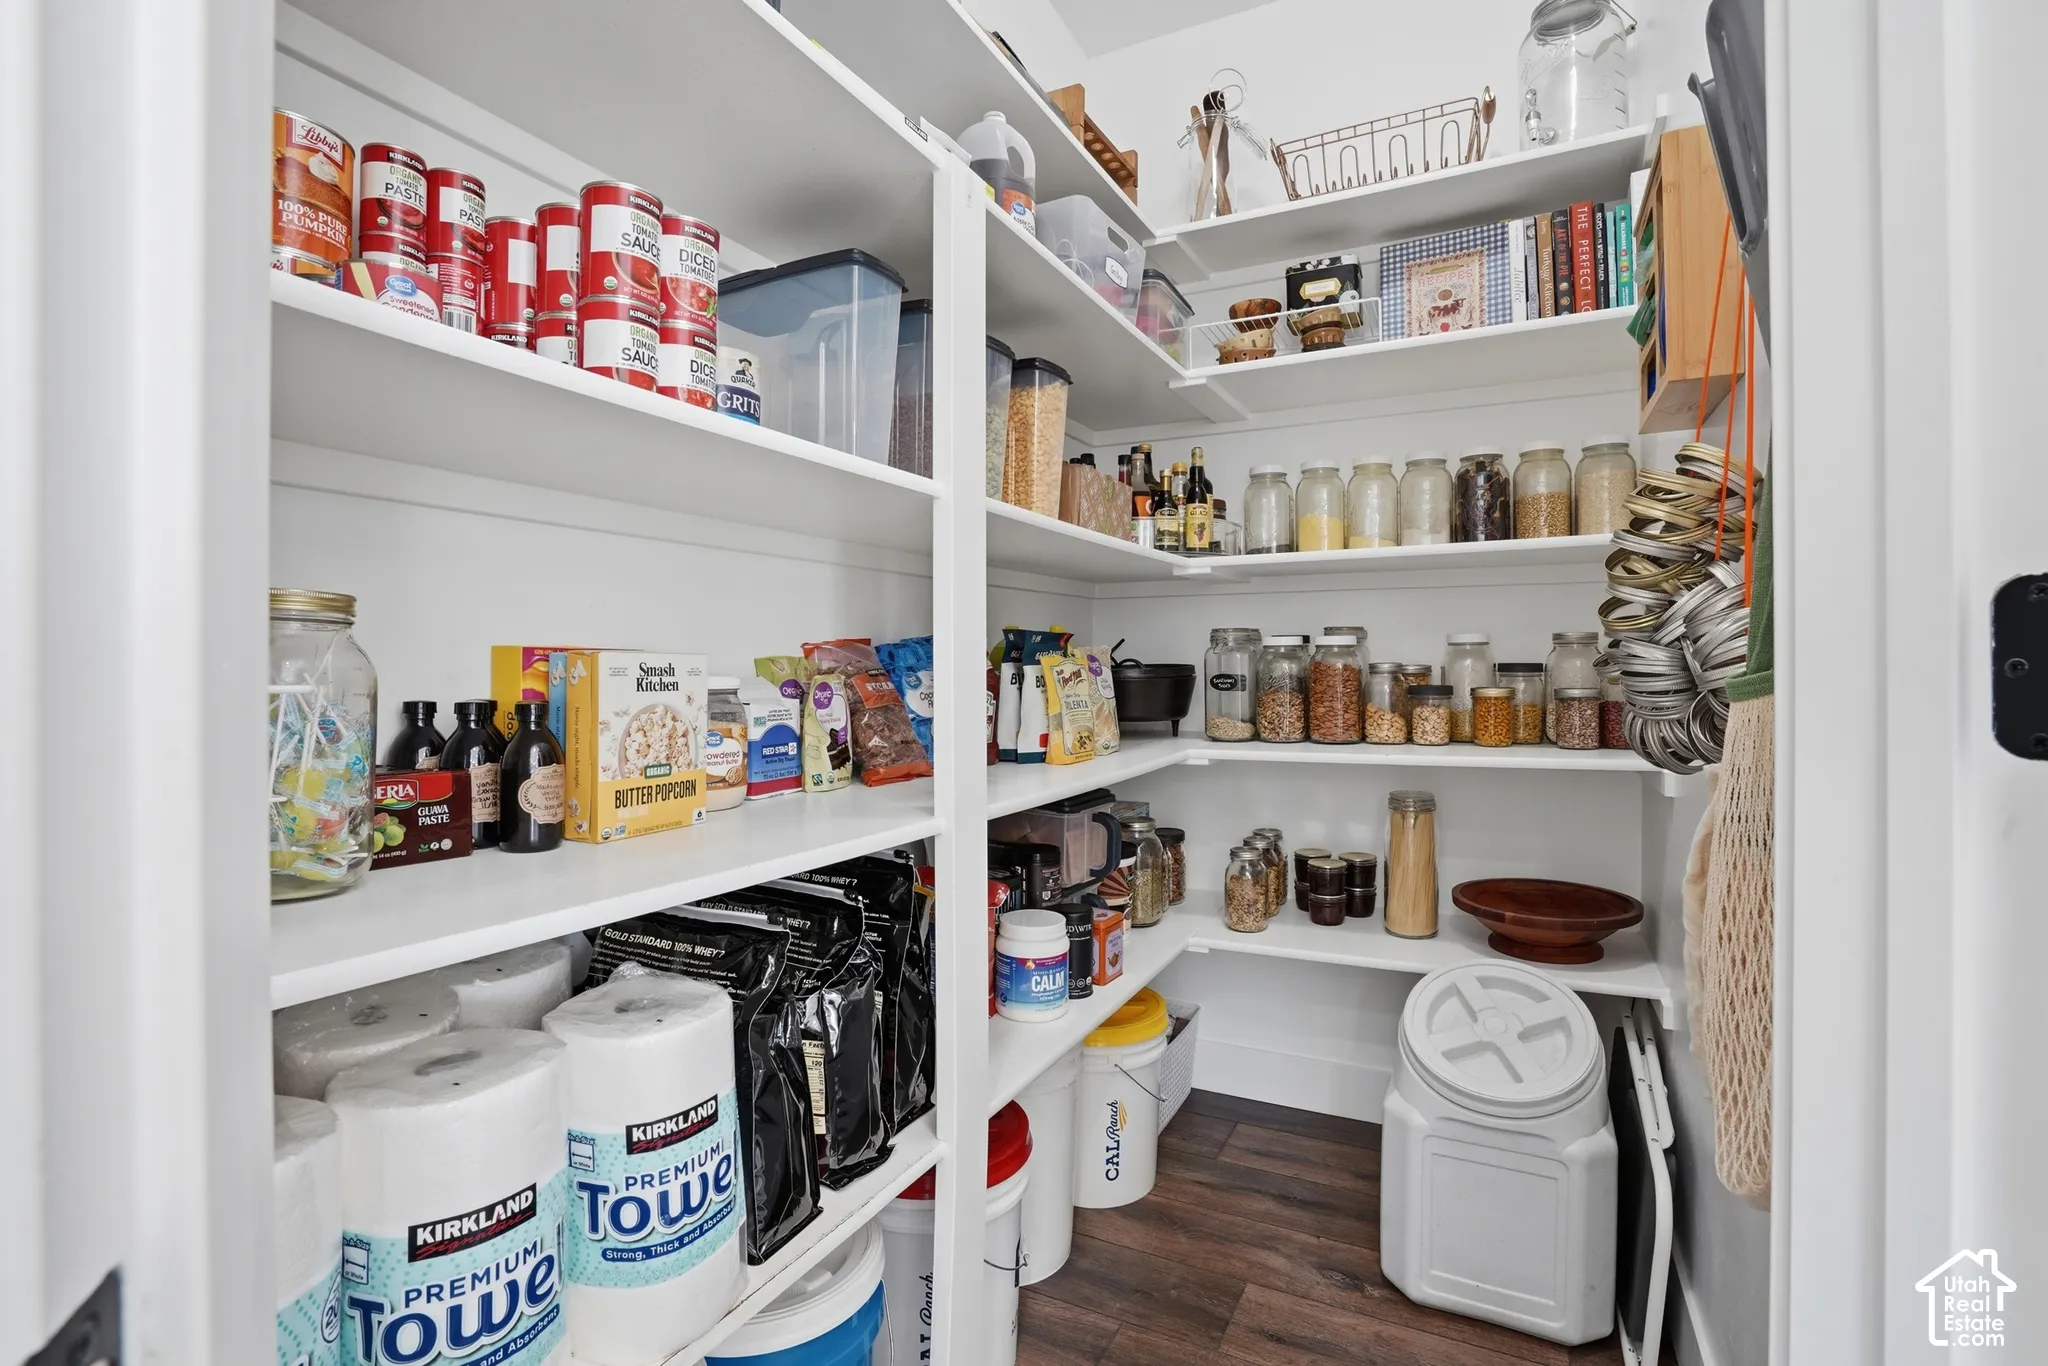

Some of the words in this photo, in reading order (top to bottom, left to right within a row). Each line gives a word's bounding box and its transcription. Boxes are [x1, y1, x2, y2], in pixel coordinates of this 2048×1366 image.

[297, 125, 339, 153] Libby's
[388, 151, 424, 171] KIRKLAND
[389, 165, 423, 187] ORGANIC
[395, 176, 419, 191] TOMATO
[385, 182, 425, 208] PASTE
[629, 195, 660, 216] KIRKLAND
[278, 199, 316, 219] 100%
[318, 212, 348, 236] PURE
[281, 212, 345, 246] PUMPKIN
[459, 209, 486, 227] PAST
[1577, 206, 1589, 229] THE
[631, 222, 659, 244] TOMATO
[684, 225, 716, 243] KIRKLAND
[1555, 228, 1567, 241] ART
[679, 248, 716, 273] DICED
[1578, 239, 1591, 290] PERFECT
[680, 262, 715, 284] TOMATOES
[1417, 269, 1473, 288] RECIPES
[1513, 267, 1524, 303] Jubilee
[389, 295, 435, 316] Sweetened
[1544, 282, 1554, 317] Kitchen
[730, 375, 756, 388] QUAKER
[717, 391, 760, 418] GRITS
[638, 662, 676, 679] Smash
[635, 677, 679, 693] Kitchen
[706, 750, 740, 760] owdered
[762, 747, 775, 756] RED
[775, 745, 789, 754] STAR
[645, 765, 671, 778] ORGANIC
[614, 784, 654, 809] BUTTER
[654, 779, 697, 803] POPCORN
[417, 804, 449, 816] GUAVA
[418, 813, 450, 826] PASTE
[811, 874, 830, 883] 100%
[604, 928, 627, 942] GOLD
[628, 934, 673, 949] STANDARD
[673, 942, 694, 953] 100%
[1031, 970, 1065, 992] CALM
[631, 1099, 717, 1143] KIRKLAND
[1105, 1099, 1121, 1140] Ranch
[631, 1116, 717, 1153] Signature
[625, 1141, 721, 1191] PREMIUM
[1105, 1139, 1120, 1181] CAL
[416, 1190, 534, 1246] KIRKLAND
[416, 1211, 534, 1260] Signature
[605, 1250, 647, 1260] Strong,
[650, 1240, 681, 1256] Thick
[683, 1227, 701, 1243] and
[404, 1241, 538, 1309] PREMIUM
[508, 1308, 559, 1353] Absorbent
